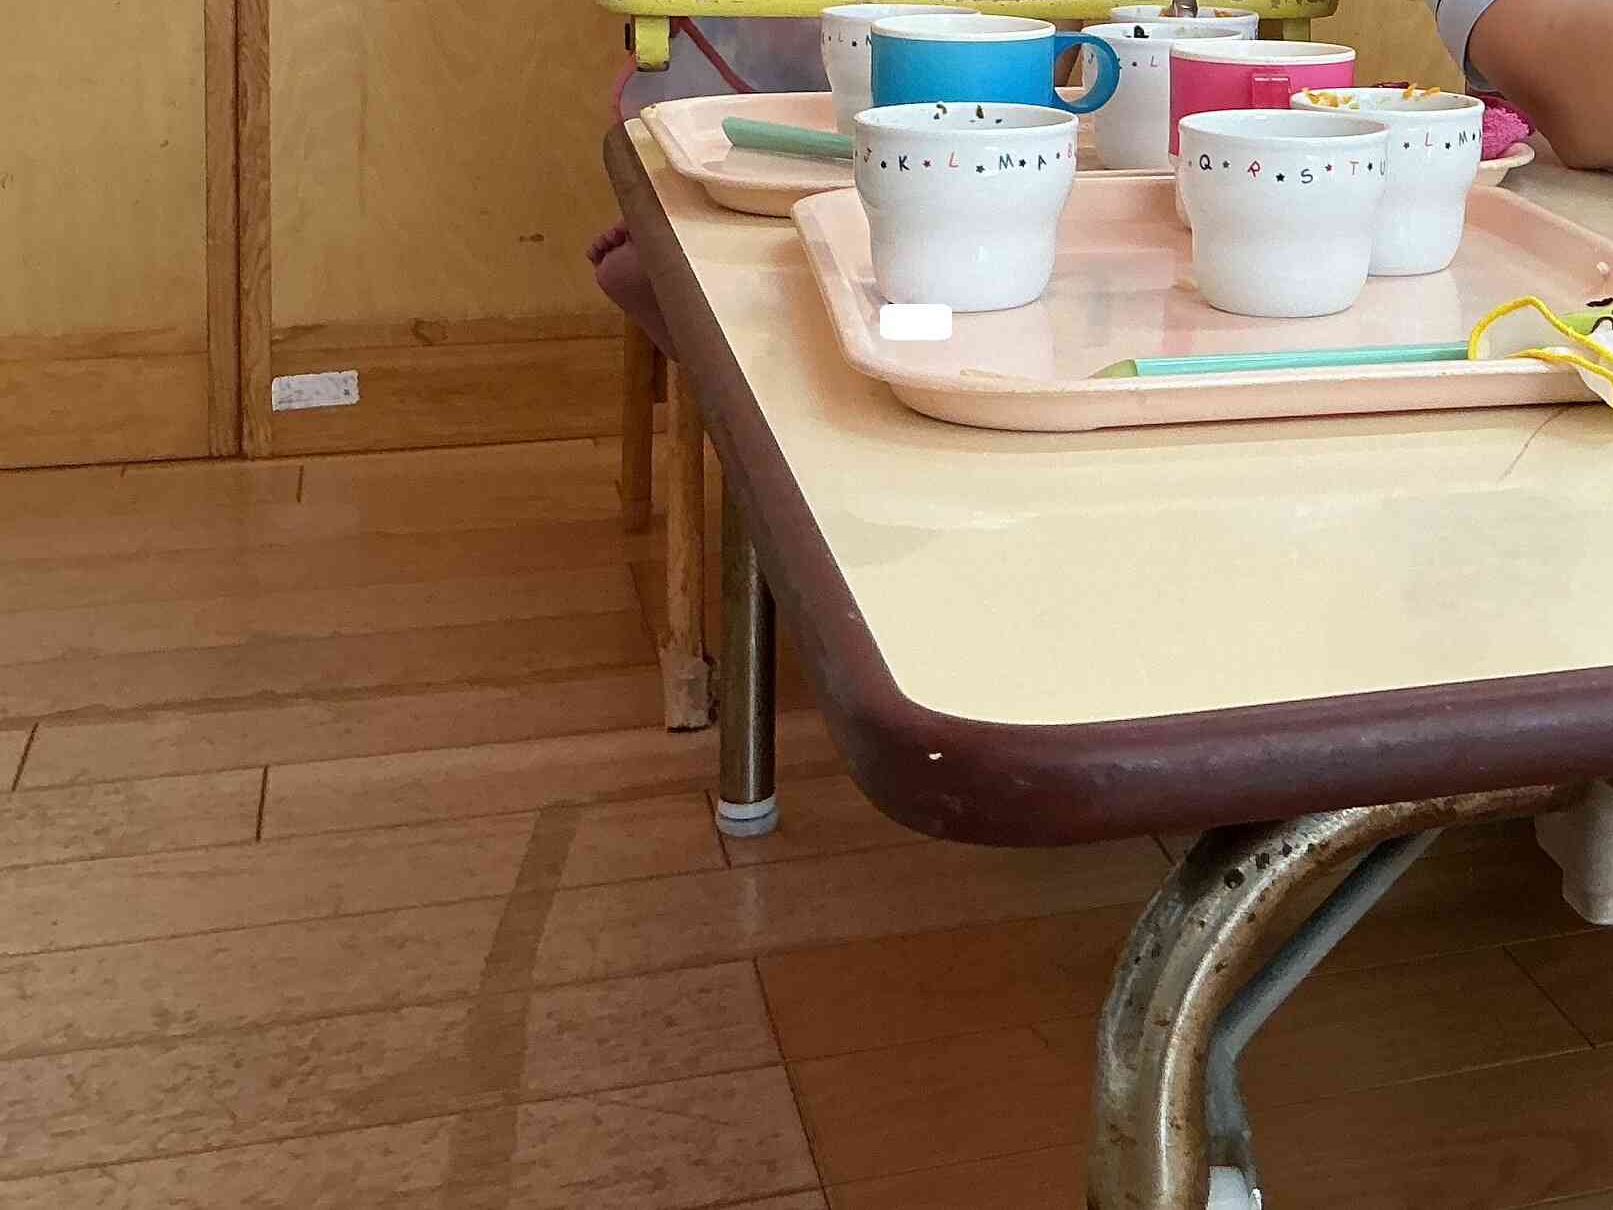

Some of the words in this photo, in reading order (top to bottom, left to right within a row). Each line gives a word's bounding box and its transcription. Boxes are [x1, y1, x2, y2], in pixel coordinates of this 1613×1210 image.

[1425, 132, 1433, 147] L
[1459, 130, 1468, 147] M
[898, 155, 911, 172] K
[948, 151, 959, 168] L
[999, 153, 1014, 170] M
[1199, 153, 1213, 171] Q
[1300, 168, 1314, 184] S
[1349, 160, 1360, 176] T
